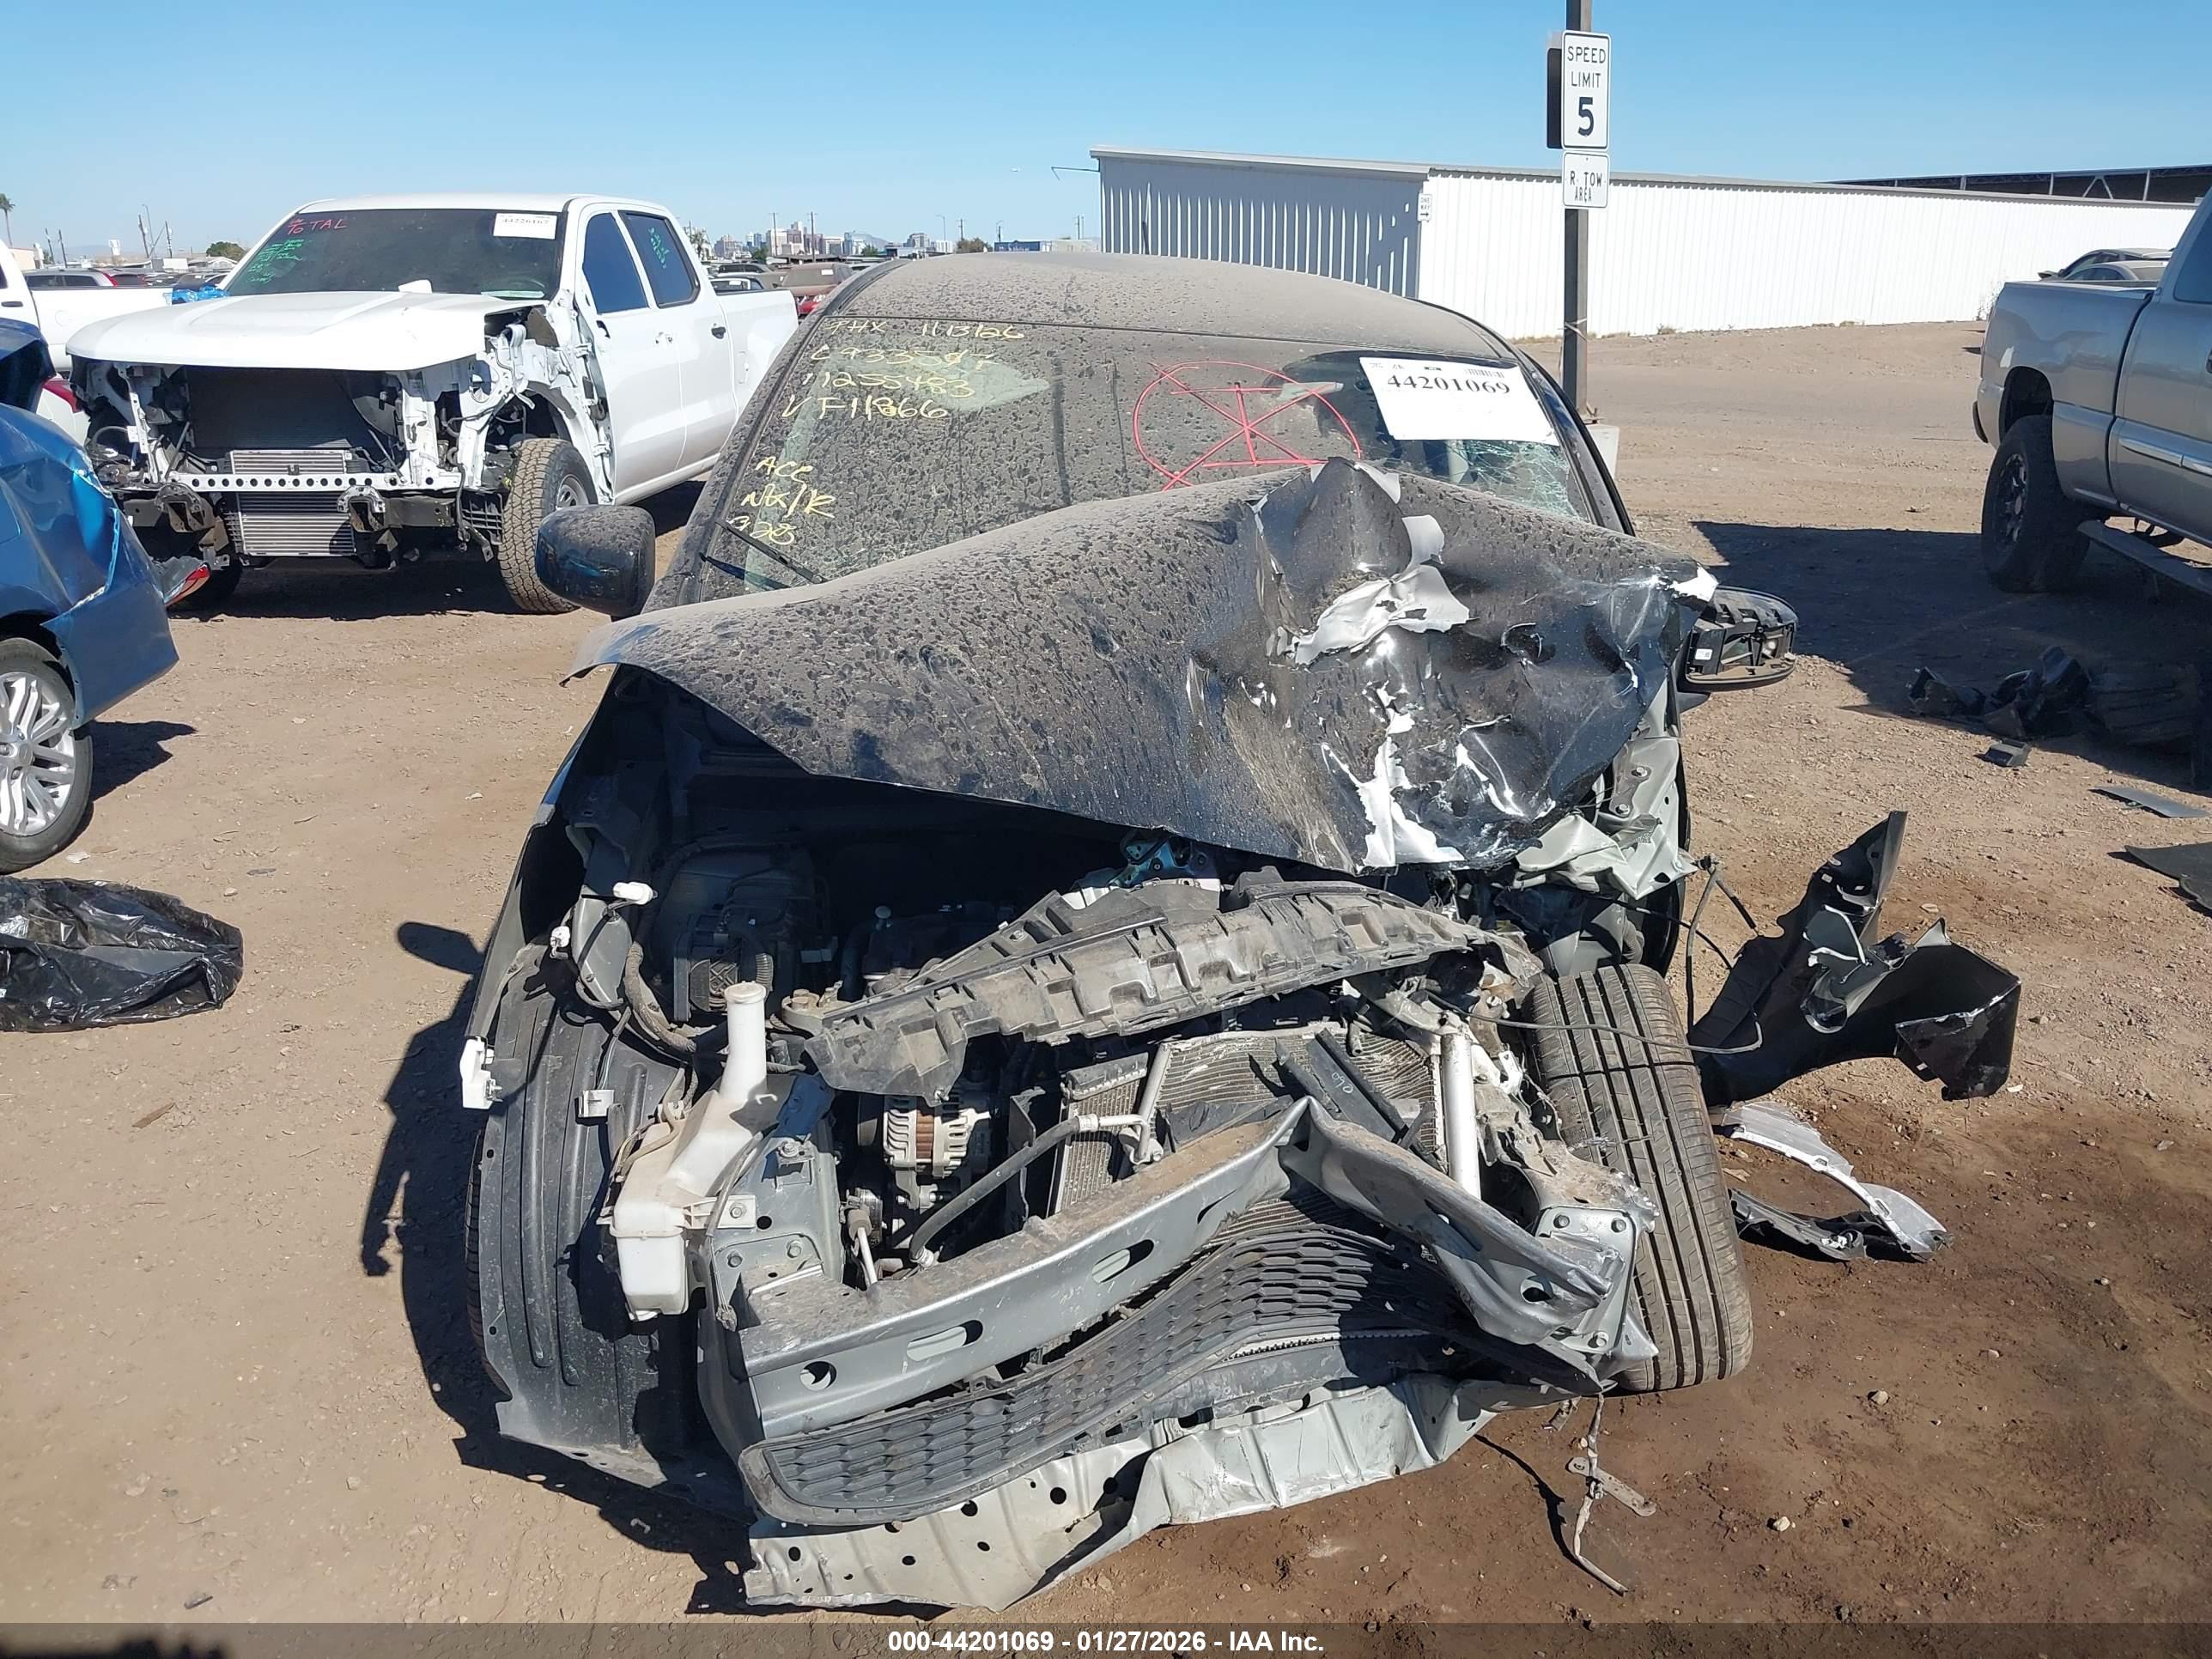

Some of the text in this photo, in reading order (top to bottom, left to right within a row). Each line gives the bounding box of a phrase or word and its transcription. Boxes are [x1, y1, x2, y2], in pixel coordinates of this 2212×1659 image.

[1567, 46, 1606, 64] SPEED
[1571, 71, 1601, 88] LIMIT
[1577, 97, 1594, 137] 5
[1583, 172, 1602, 187] TOW
[1388, 374, 1510, 394] 44201069
